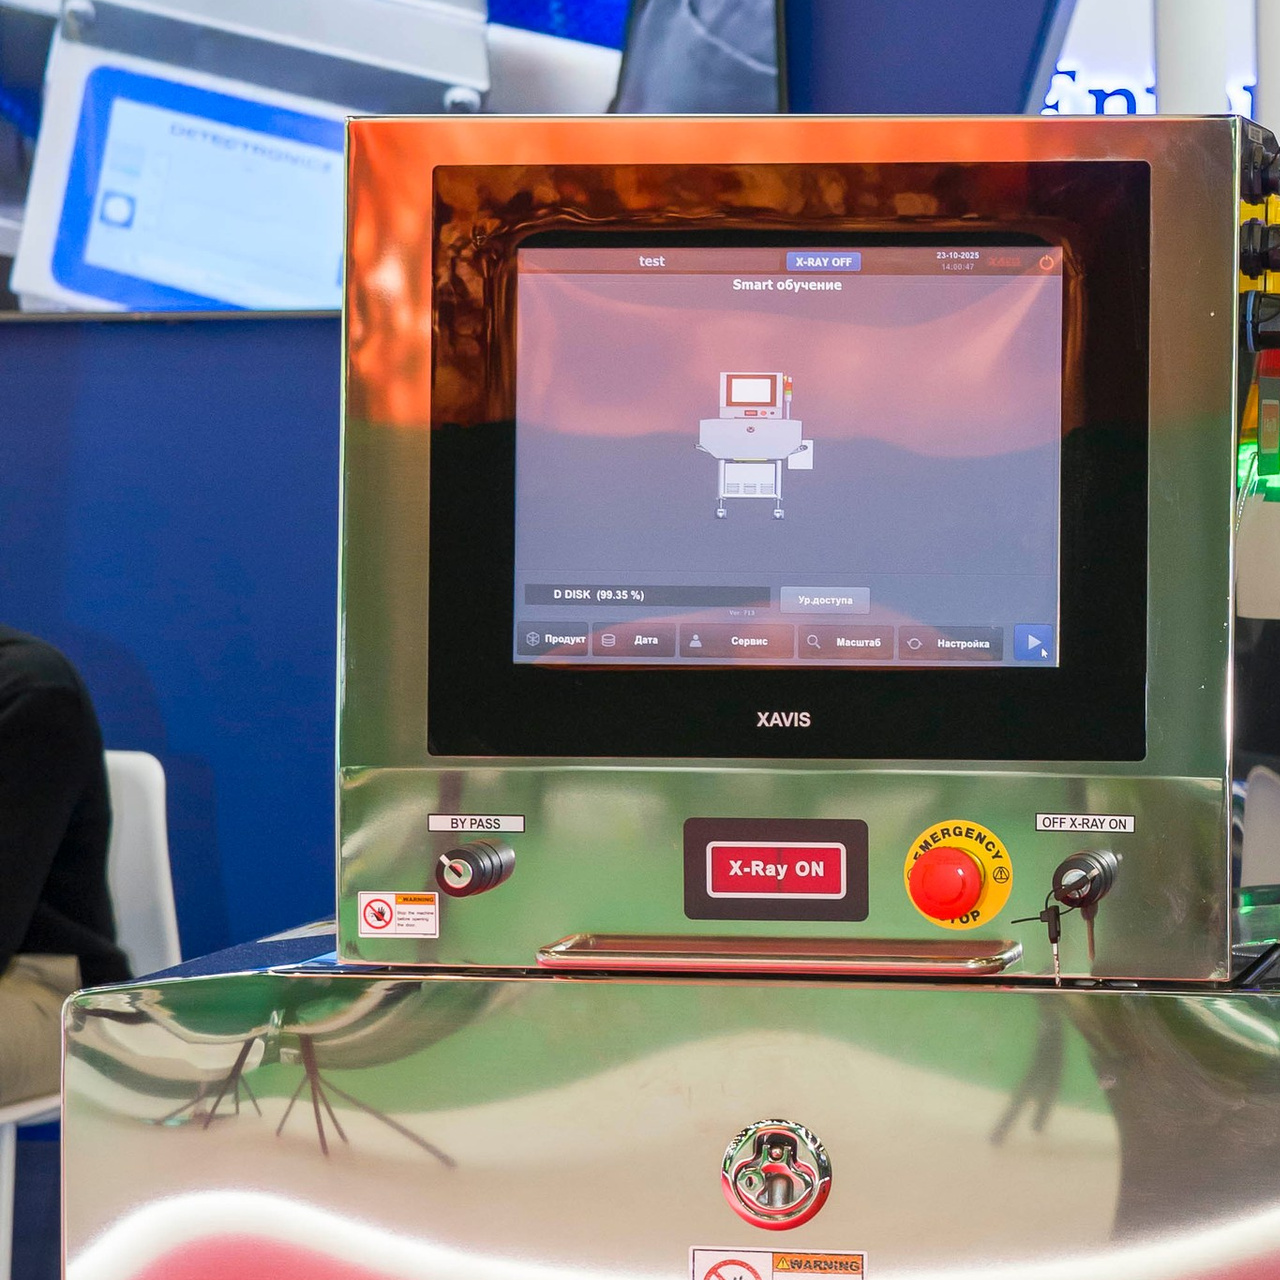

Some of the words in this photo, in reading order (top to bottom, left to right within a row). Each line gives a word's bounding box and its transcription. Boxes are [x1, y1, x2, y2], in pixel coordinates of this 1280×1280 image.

[639, 255, 666, 267] test
[795, 257, 829, 267] X-RAY
[832, 257, 853, 267] OFF
[936, 251, 980, 260] 23-10-2025
[732, 278, 774, 291] Smart
[776, 278, 843, 294] обучение
[553, 589, 562, 599] D
[564, 589, 592, 599] DISK
[596, 589, 629, 601] (99.35
[630, 589, 645, 602] %)
[798, 594, 853, 607] Ур.доступа
[545, 634, 587, 645] Продукт
[634, 635, 659, 646] Дата
[731, 636, 769, 648] Сервис
[836, 637, 882, 648] Масштаб
[937, 638, 991, 650] Настройка
[756, 711, 811, 727] XAVIS
[450, 817, 467, 829] BY
[469, 817, 501, 830] PASS
[1042, 816, 1067, 829] OFF
[1069, 816, 1106, 830] X-RAY
[1108, 818, 1127, 830] ON
[728, 860, 788, 880] X-Ray
[795, 860, 825, 877] ON
[789, 1258, 860, 1271] WARNING
